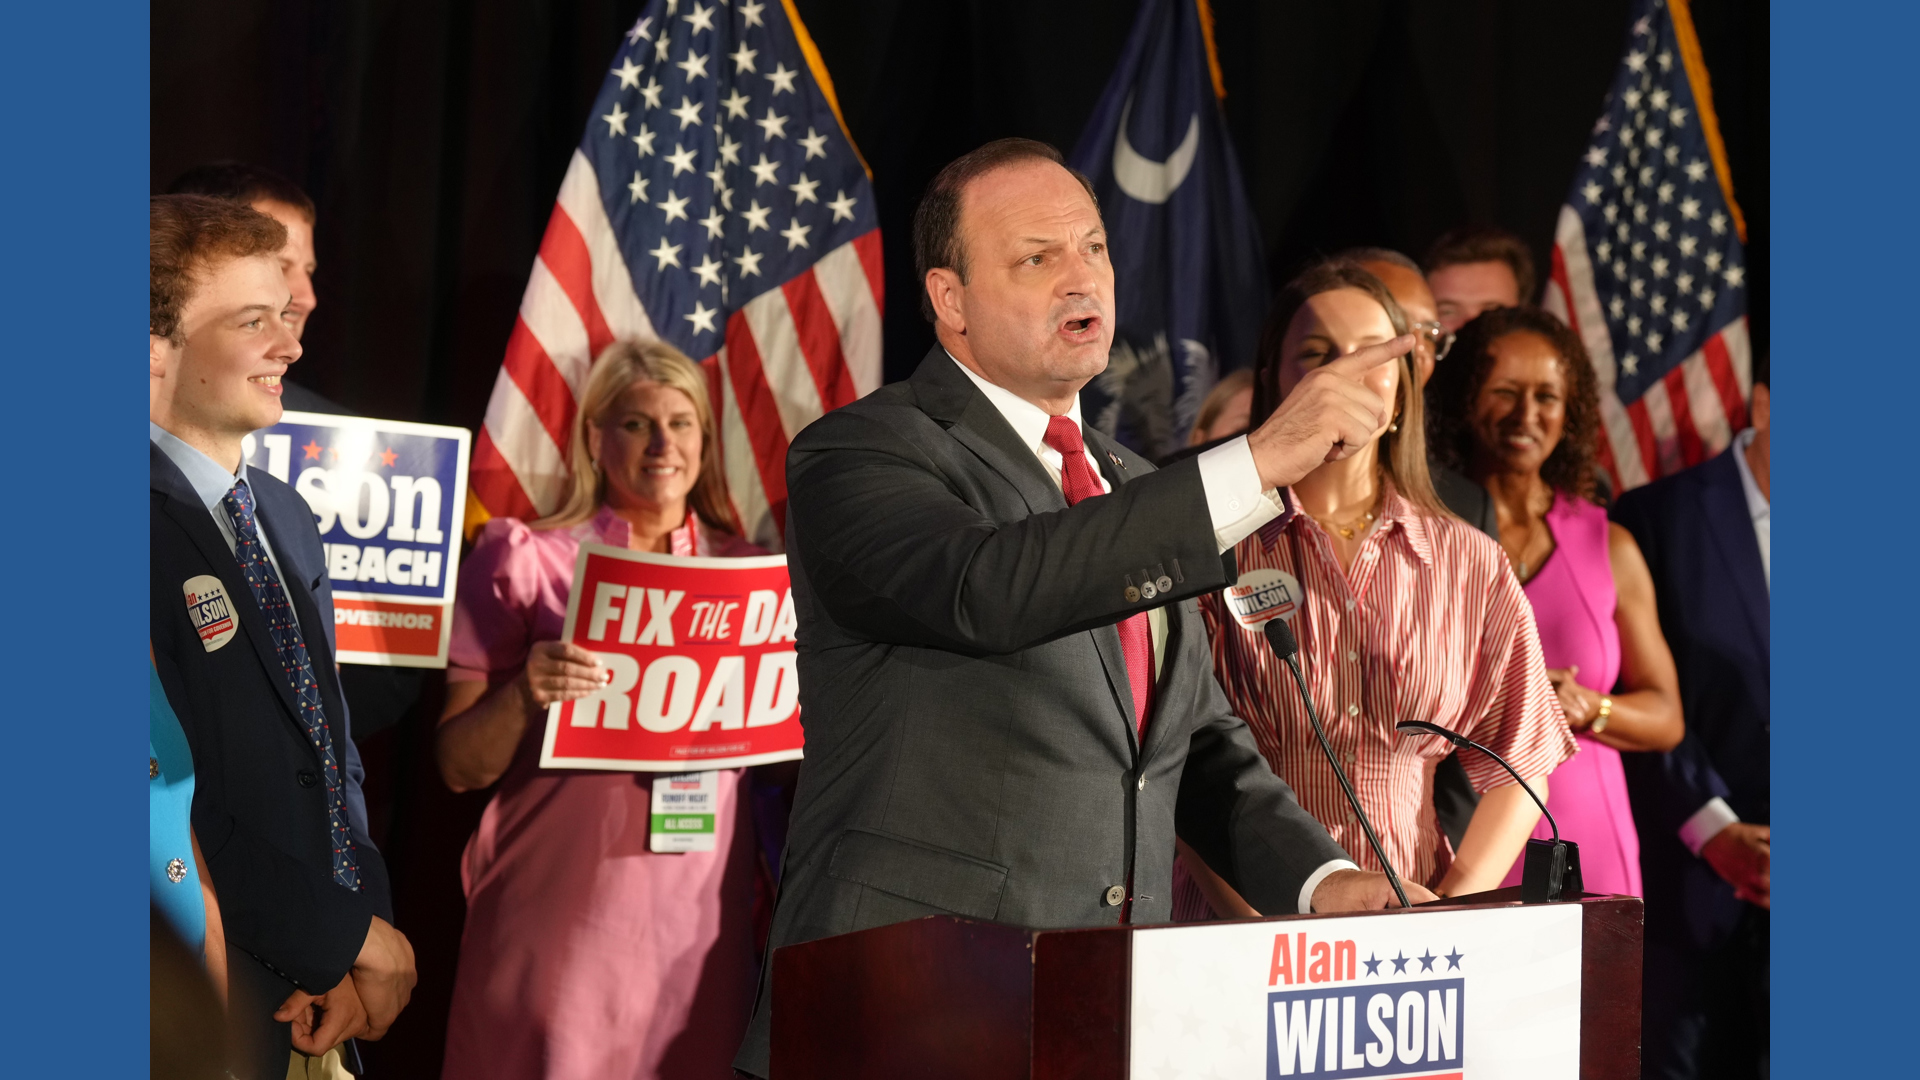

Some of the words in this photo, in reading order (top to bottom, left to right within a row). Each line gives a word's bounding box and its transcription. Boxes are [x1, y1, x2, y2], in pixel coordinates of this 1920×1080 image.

[241, 433, 443, 545] lson
[587, 581, 685, 647] FIX
[688, 600, 739, 640] THE
[739, 586, 798, 646] DA
[1234, 587, 1290, 615] WILSON
[570, 650, 801, 733] ROAD
[1268, 932, 1356, 986] Alan
[1273, 988, 1459, 1076] WILSON
